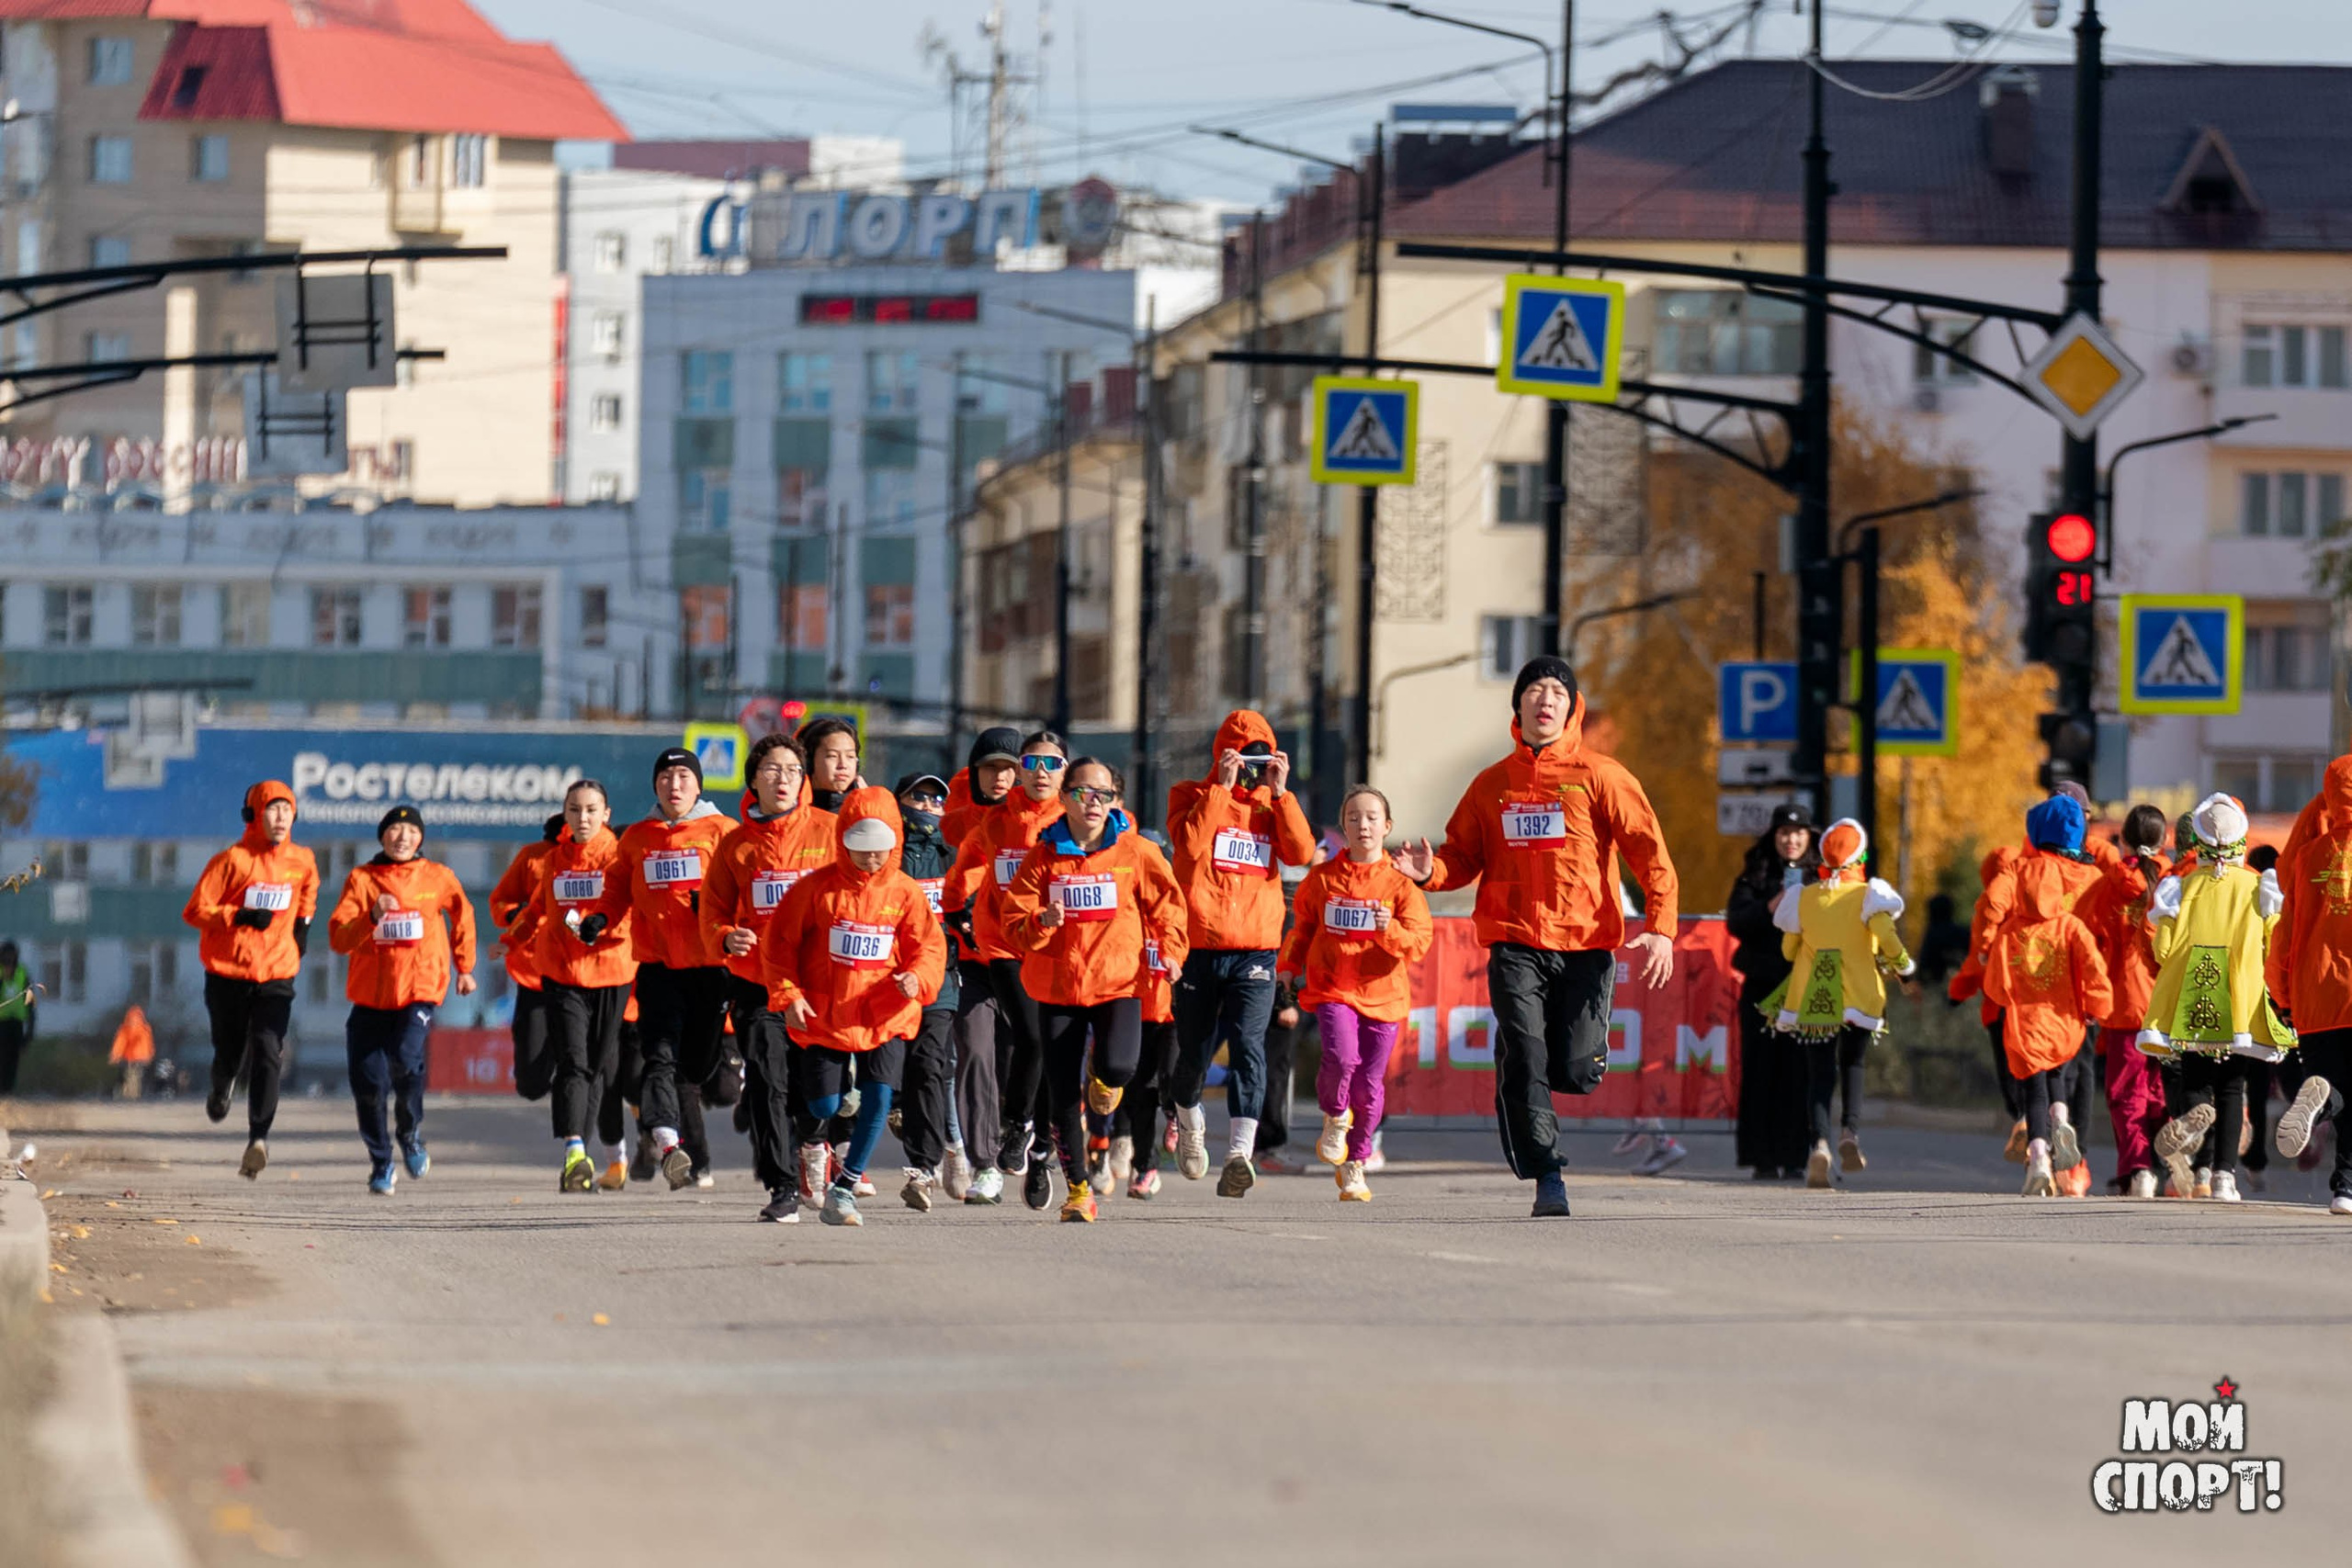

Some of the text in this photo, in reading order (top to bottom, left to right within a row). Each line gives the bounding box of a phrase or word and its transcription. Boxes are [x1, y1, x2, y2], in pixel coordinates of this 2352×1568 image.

[777, 186, 1040, 260] ЛОРП
[2057, 570, 2093, 605] 21
[292, 751, 583, 801] Ростелеком
[1515, 815, 1551, 837] 1392
[1227, 840, 1261, 863] 0034
[655, 860, 687, 880] 0961
[564, 879, 594, 897] 0080
[1063, 886, 1102, 908] 0068
[255, 892, 283, 908] 0077
[1334, 908, 1369, 928] 0067
[382, 921, 413, 939] 0018
[842, 933, 881, 956] 0036
[1408, 1005, 1642, 1072] 100
